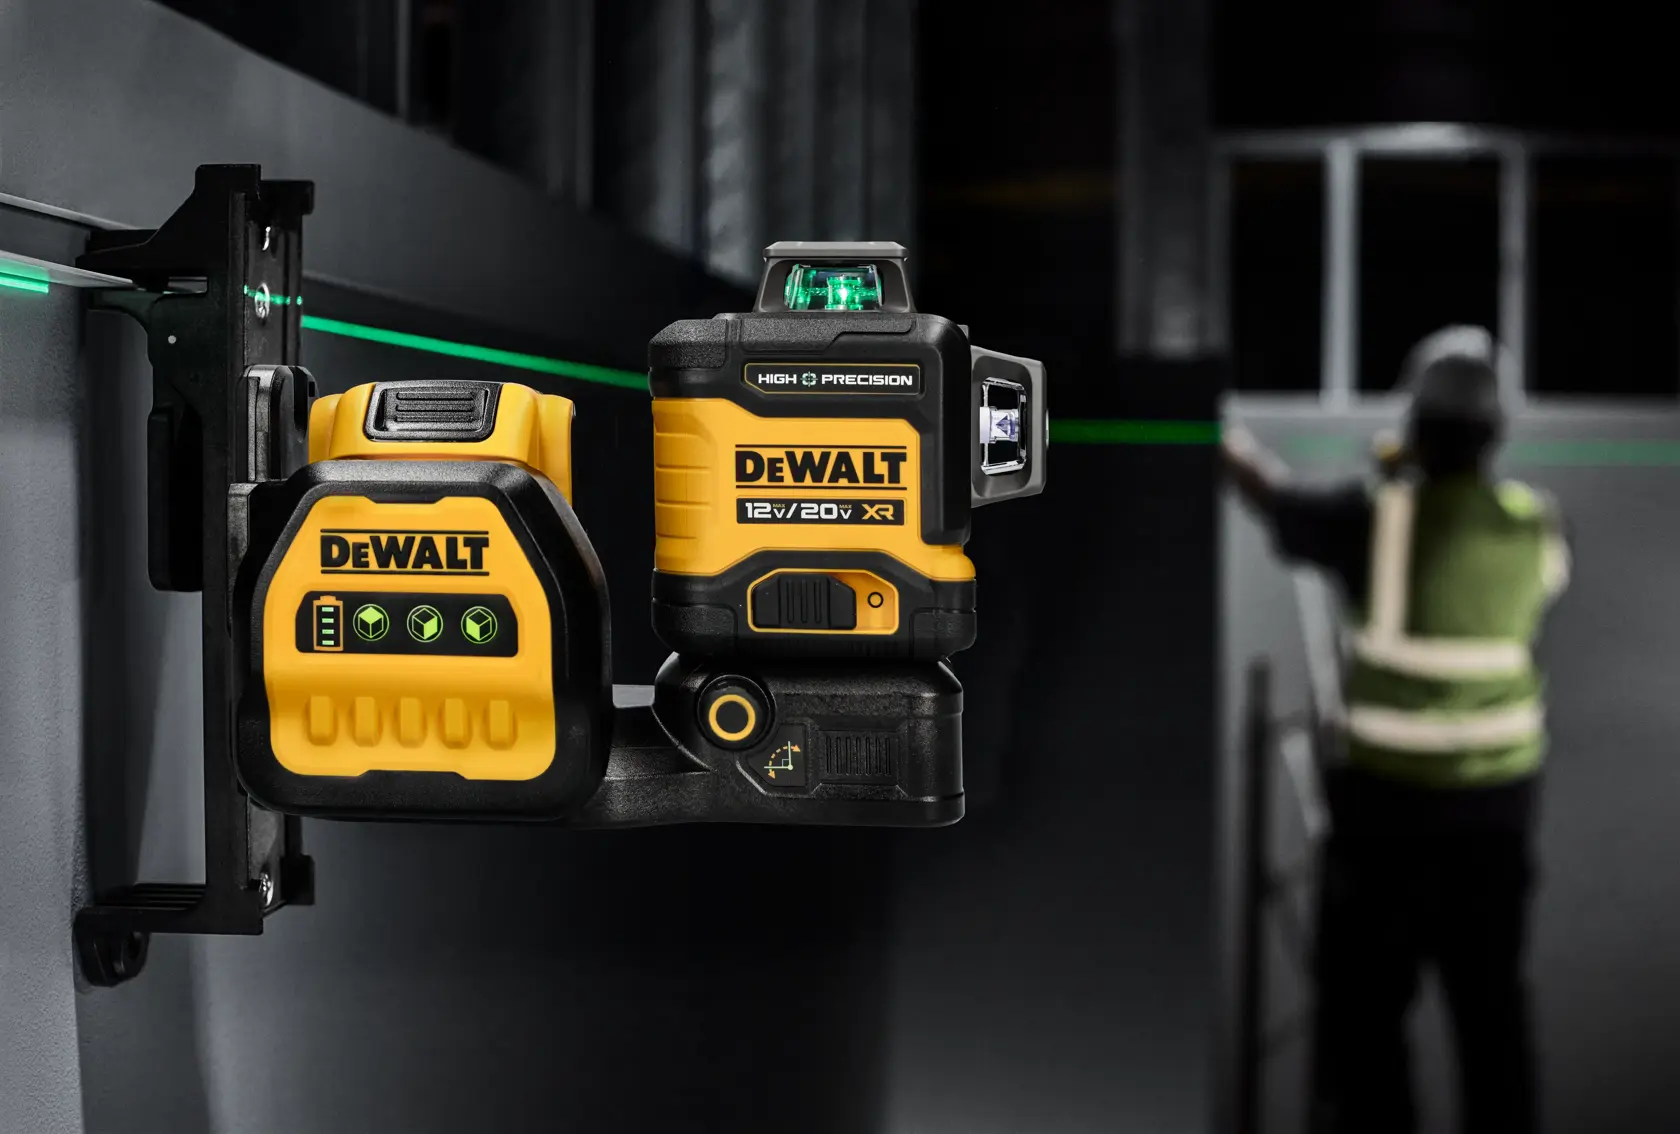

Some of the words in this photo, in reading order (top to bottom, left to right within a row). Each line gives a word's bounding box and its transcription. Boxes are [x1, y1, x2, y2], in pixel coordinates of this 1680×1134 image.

[758, 373, 797, 384] HIGH
[821, 374, 912, 386] PRECISION
[735, 450, 907, 484] DEWALT
[861, 503, 895, 521] XR
[320, 534, 490, 570] DEWALT
